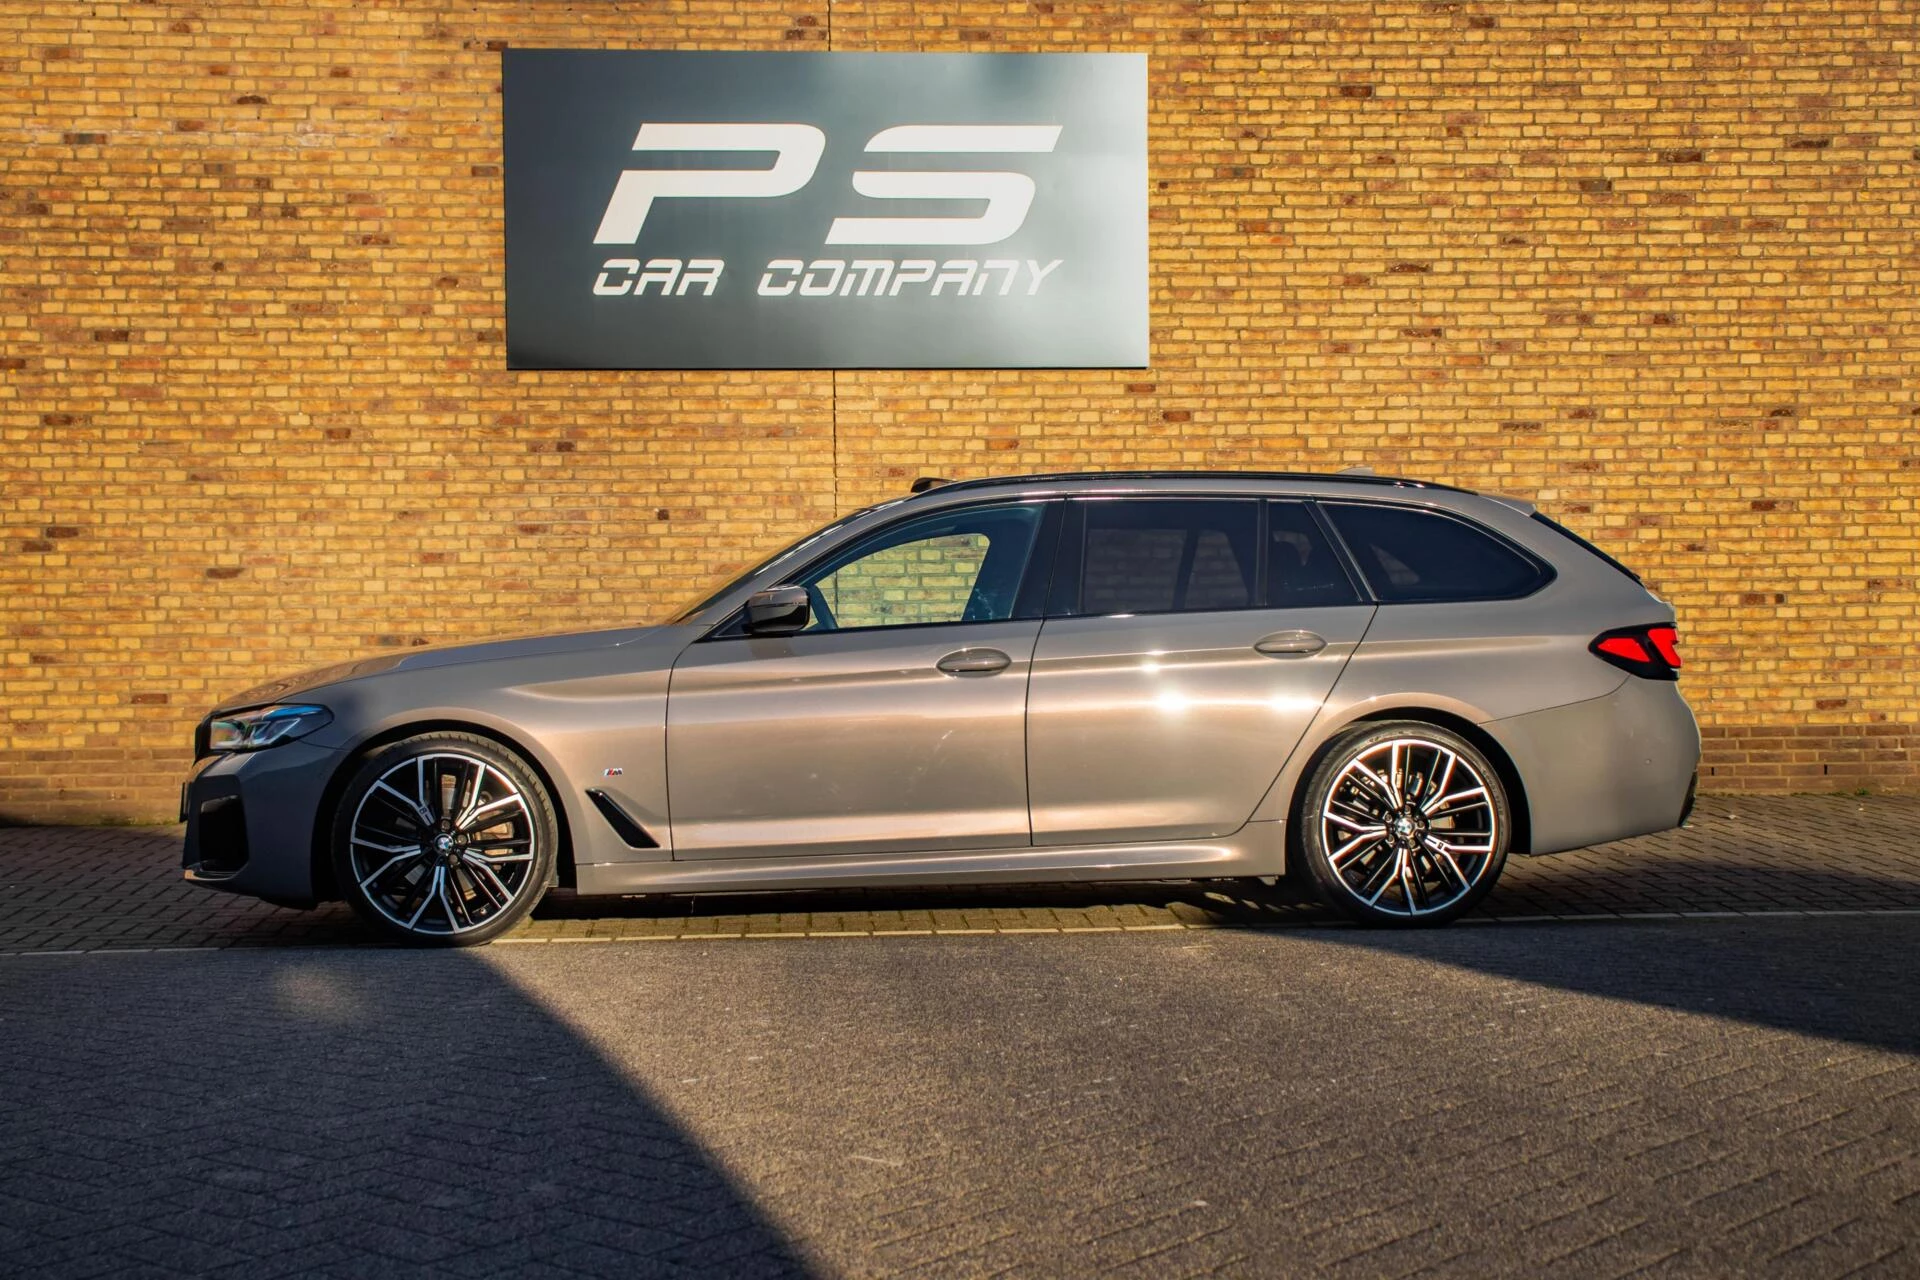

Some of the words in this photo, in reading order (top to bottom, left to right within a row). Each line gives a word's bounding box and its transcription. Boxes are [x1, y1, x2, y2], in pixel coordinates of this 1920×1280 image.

[593, 123, 1063, 245] PS
[593, 259, 724, 296] CAR
[757, 259, 1064, 297] COMPANY
